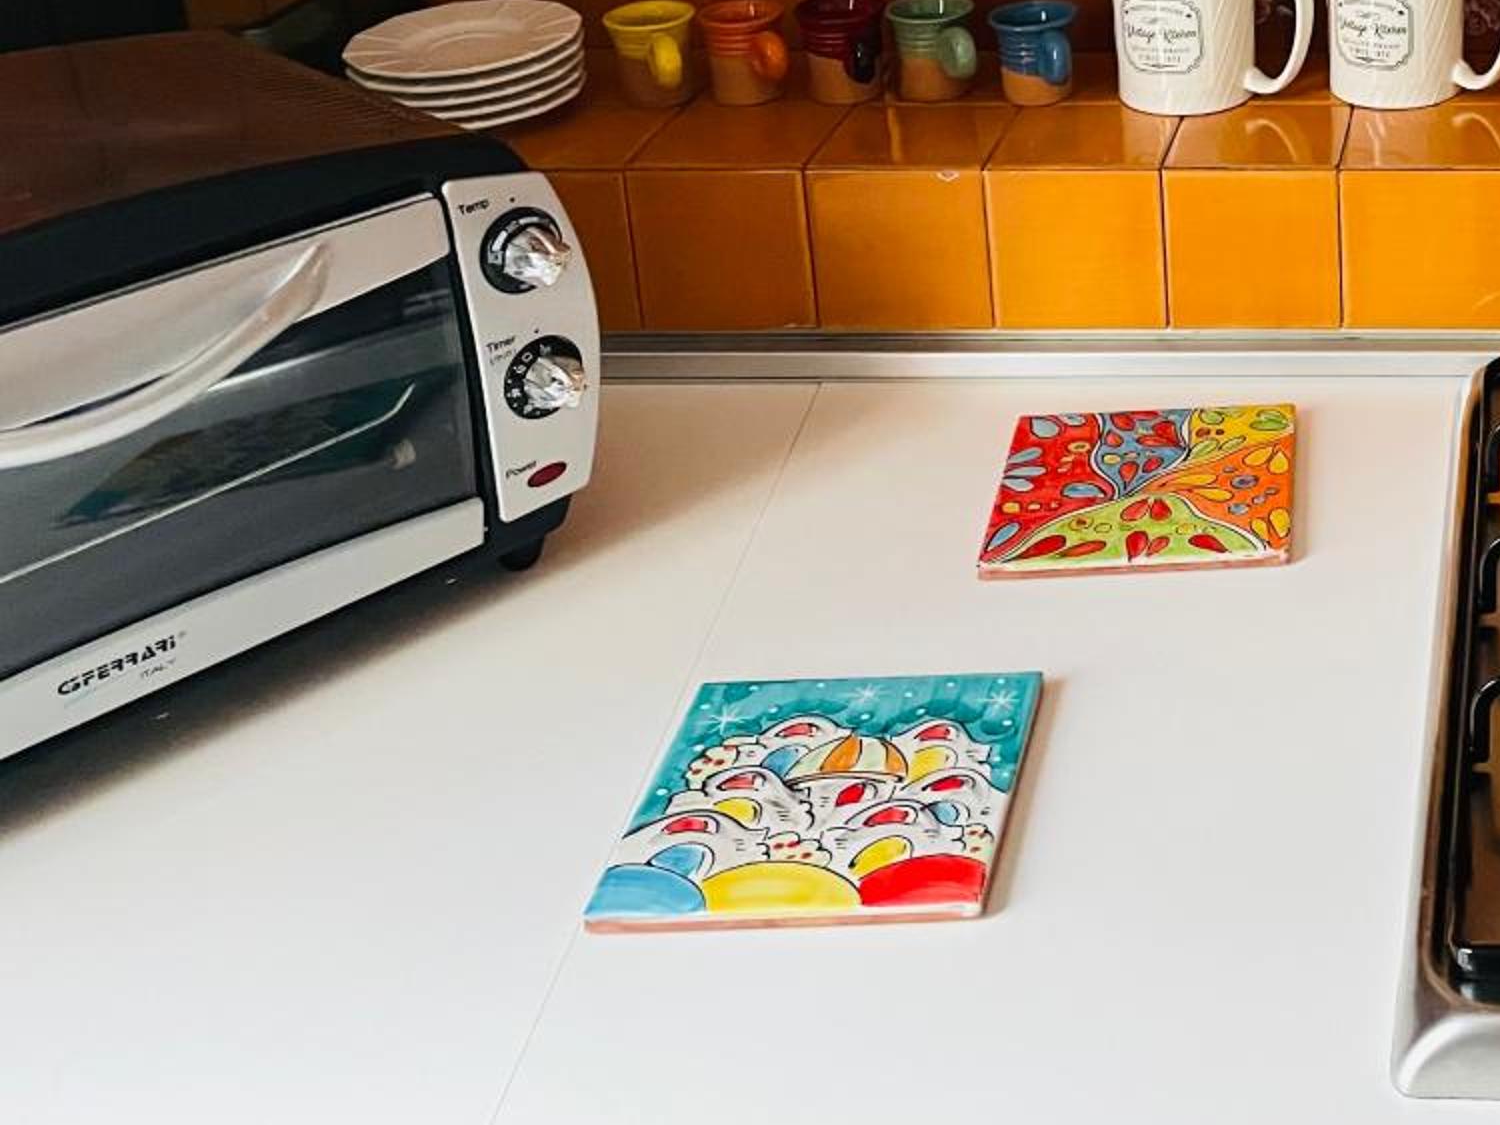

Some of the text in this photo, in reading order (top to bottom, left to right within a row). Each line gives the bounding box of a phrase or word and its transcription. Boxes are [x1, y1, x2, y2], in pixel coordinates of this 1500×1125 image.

[457, 197, 490, 216] Temp
[485, 336, 516, 352] Timer
[504, 460, 538, 479] Power
